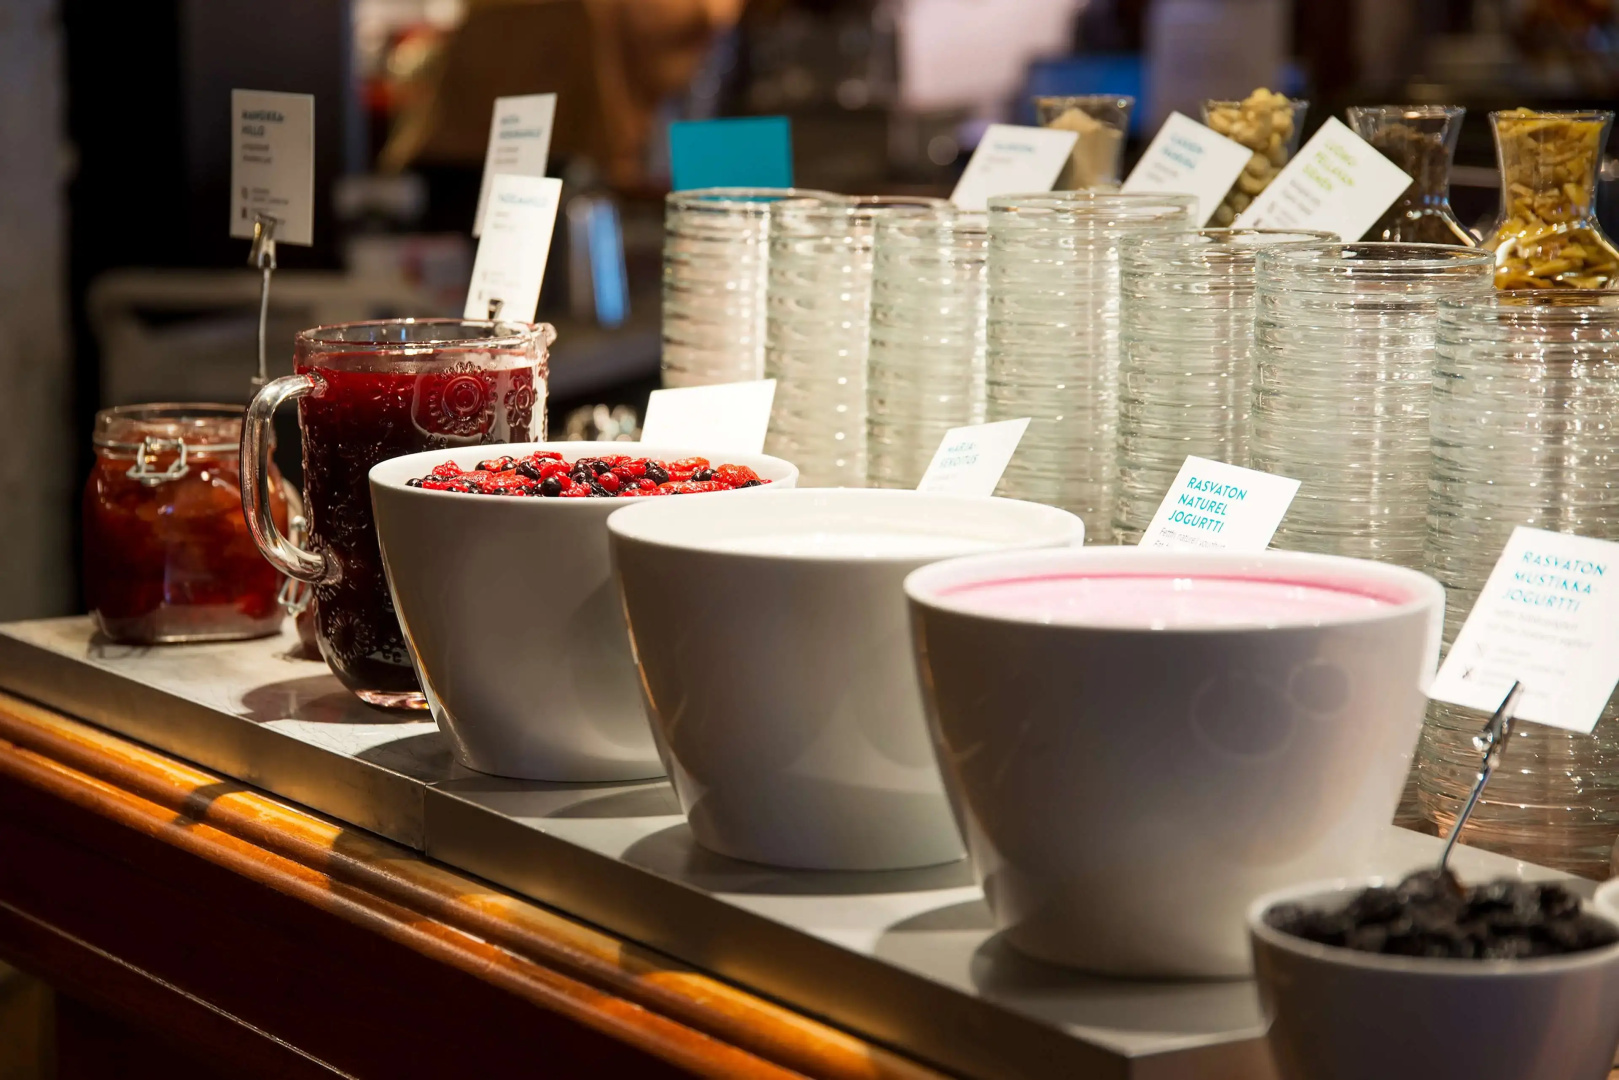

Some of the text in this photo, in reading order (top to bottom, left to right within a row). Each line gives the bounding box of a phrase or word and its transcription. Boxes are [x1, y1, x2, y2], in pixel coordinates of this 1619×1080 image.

[1186, 476, 1248, 501] RASVATON
[1177, 493, 1228, 516] NATUREL
[1167, 509, 1225, 533] JOGURTTI
[1522, 551, 1607, 577] RASVATON
[1502, 589, 1582, 613] JOGURTTI
